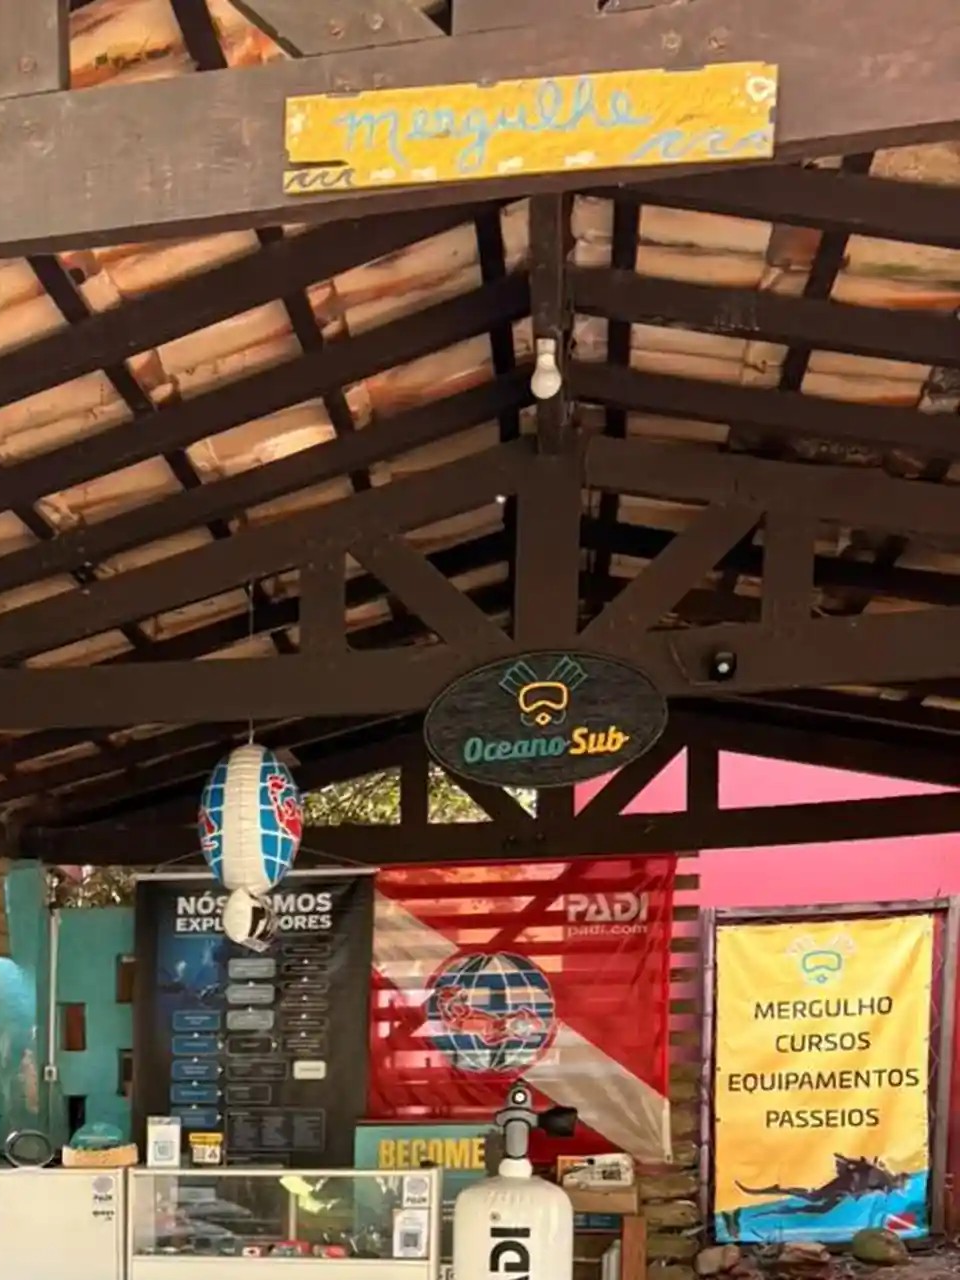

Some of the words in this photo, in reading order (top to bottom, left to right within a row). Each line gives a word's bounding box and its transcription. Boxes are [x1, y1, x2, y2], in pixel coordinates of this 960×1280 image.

[464, 736, 570, 763] Oceano
[569, 725, 629, 755] Sub
[567, 892, 649, 922] PADI
[567, 924, 647, 937] padi.com
[754, 996, 892, 1020] MERGULHO
[775, 1032, 871, 1053] CURSOS
[728, 1068, 920, 1094] EQUIPAMENTOS
[766, 1108, 879, 1129] PASSEIOS
[378, 1137, 486, 1170] BECOME
